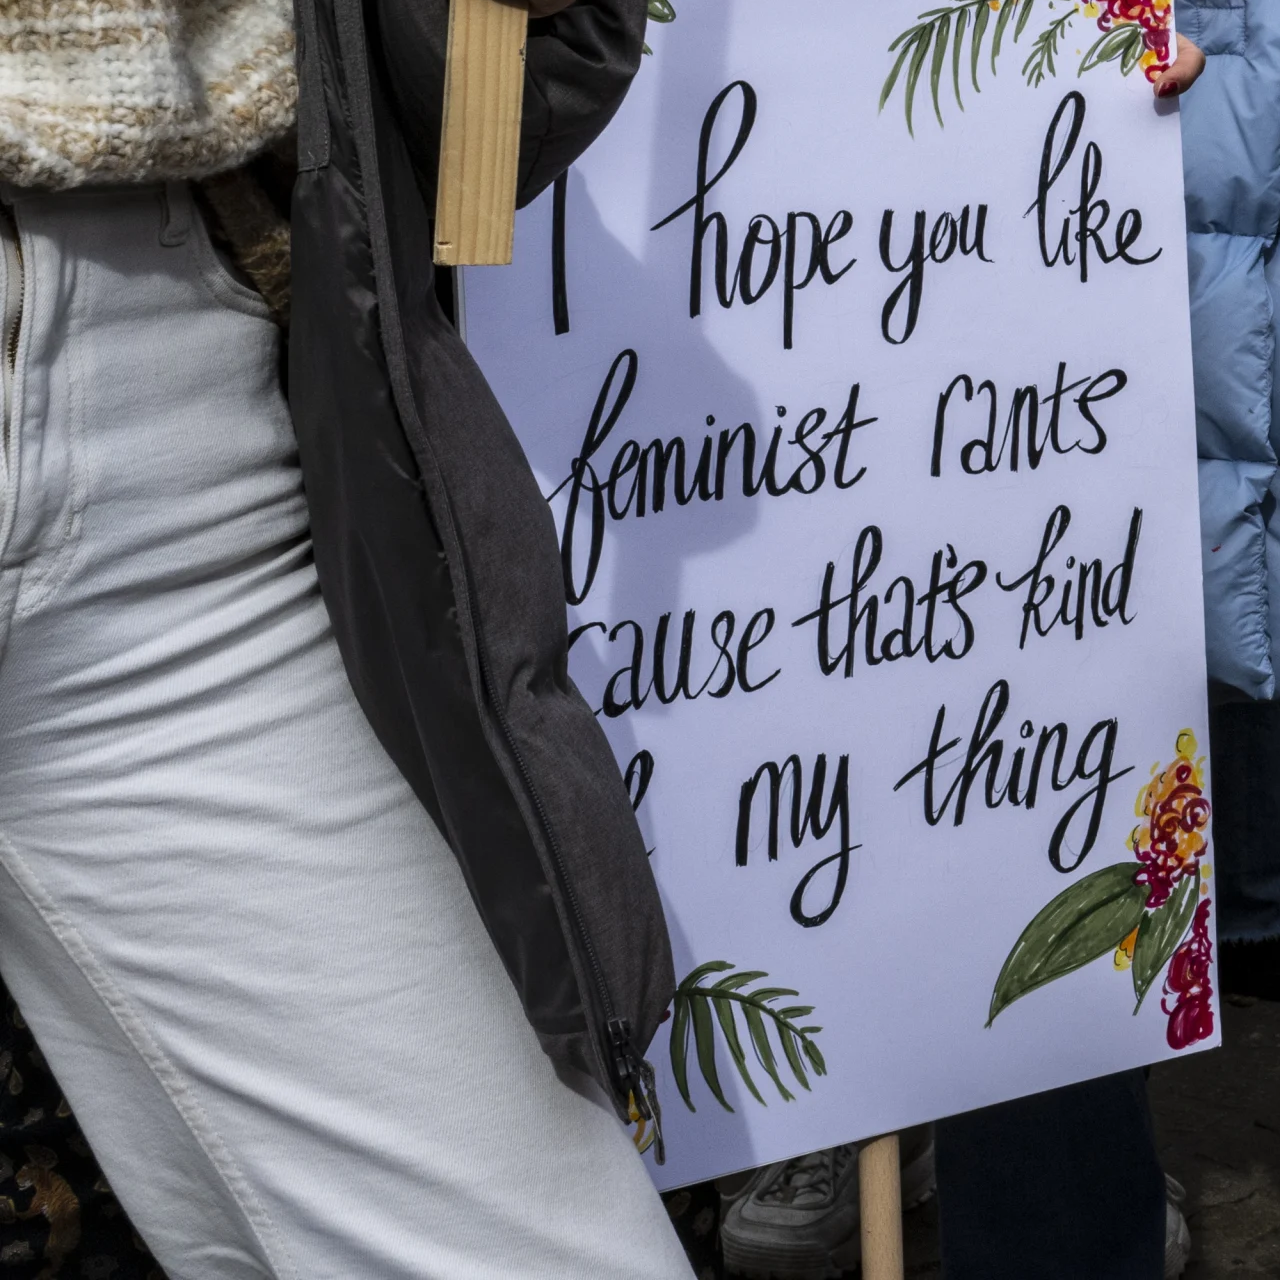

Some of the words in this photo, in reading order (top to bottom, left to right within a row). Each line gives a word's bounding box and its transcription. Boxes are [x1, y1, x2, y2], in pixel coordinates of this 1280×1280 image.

[650, 80, 856, 349] hope
[879, 203, 994, 345] you
[1024, 90, 1163, 283] like
[547, 349, 878, 606] feminist
[931, 362, 1127, 477] rants
[996, 504, 1143, 650] kind
[735, 753, 863, 928] my
[894, 679, 1136, 873] thing
